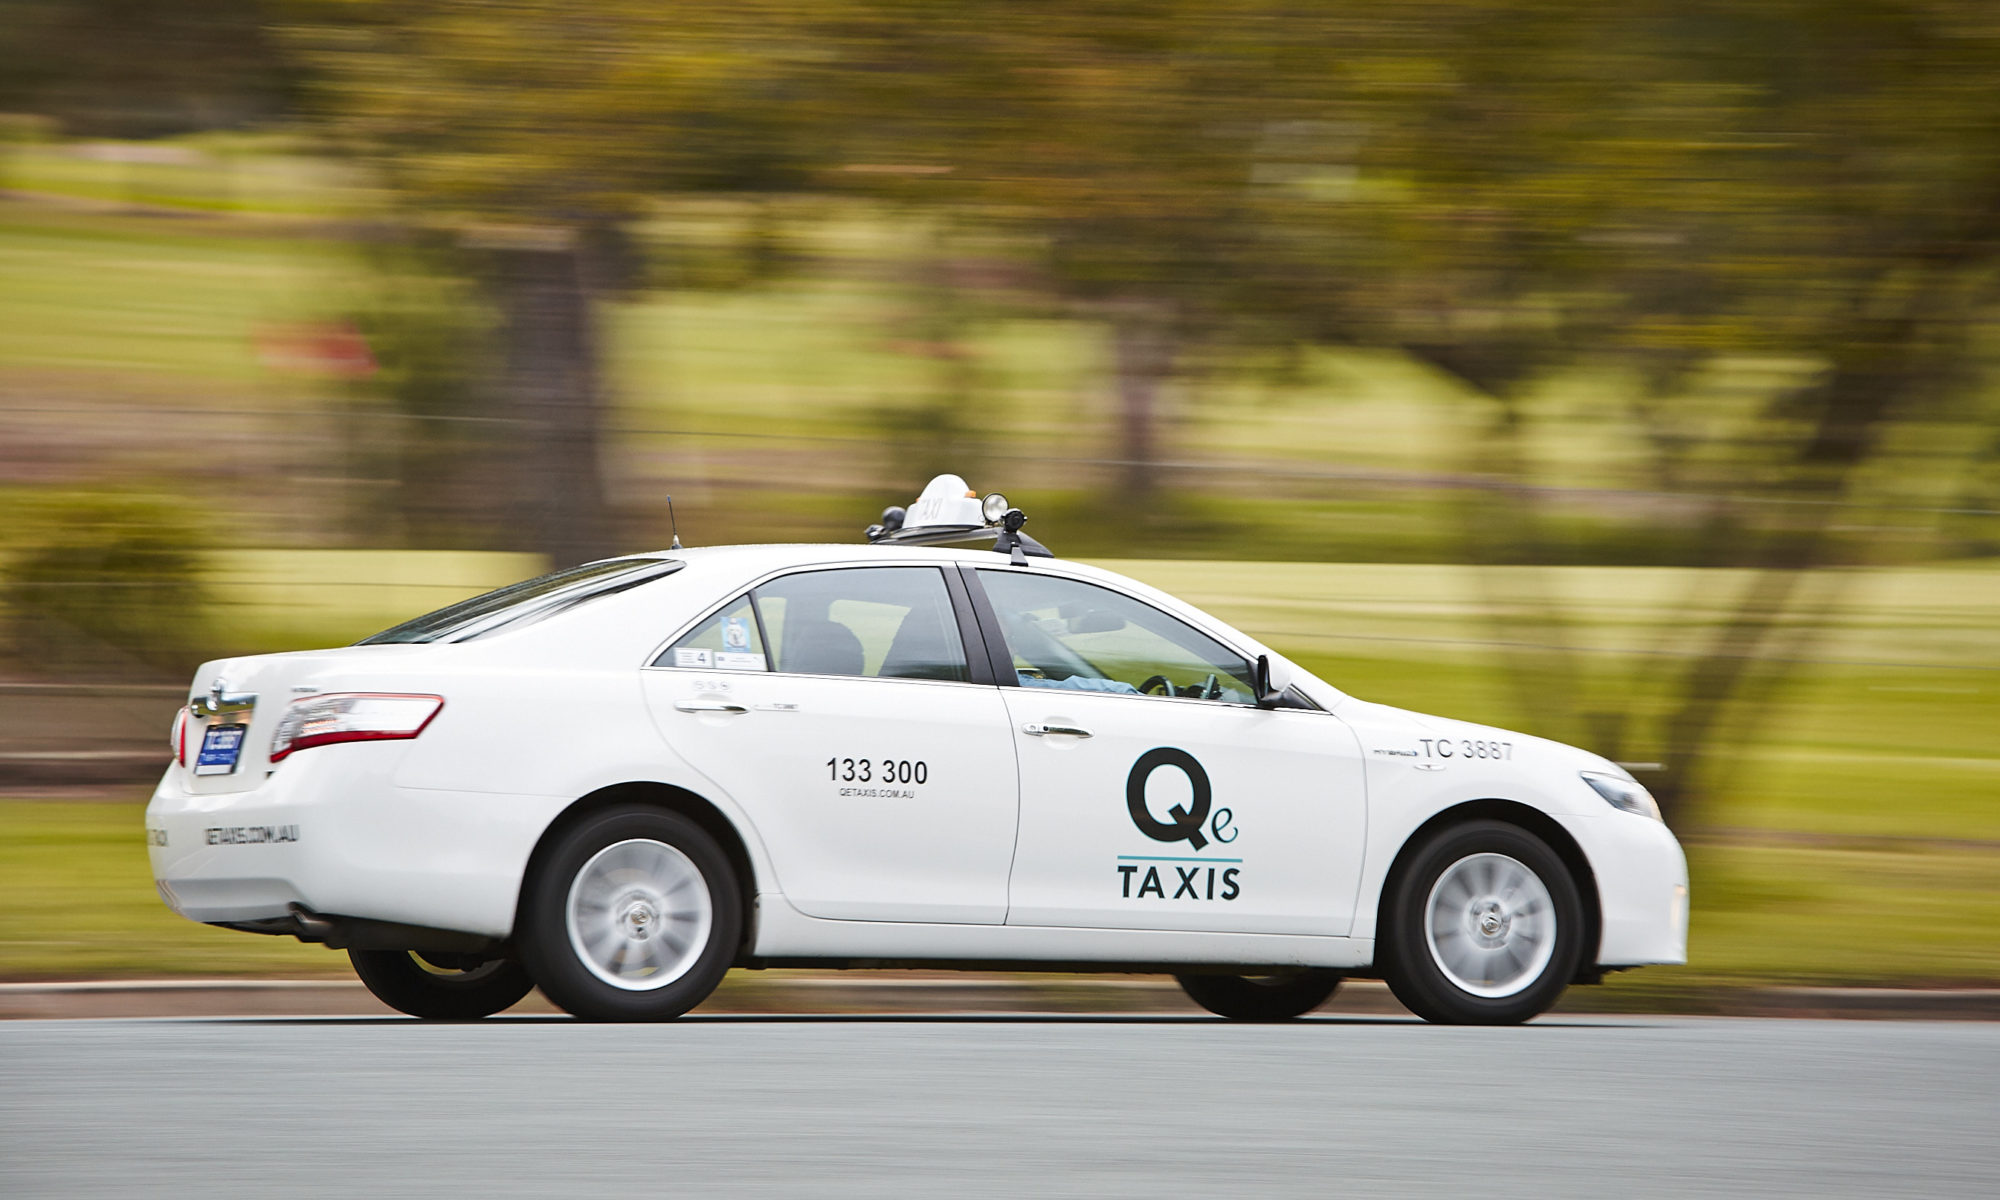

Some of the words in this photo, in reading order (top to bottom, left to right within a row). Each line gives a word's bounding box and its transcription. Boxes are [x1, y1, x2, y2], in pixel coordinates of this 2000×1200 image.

[1419, 738, 1453, 758] TC
[1461, 740, 1513, 760] 3887
[826, 757, 872, 782] 133
[882, 760, 928, 784] 300
[839, 787, 915, 799] QETAXIS.COM.AU
[1126, 746, 1239, 852] Qe
[1117, 865, 1241, 901] TAXIS
